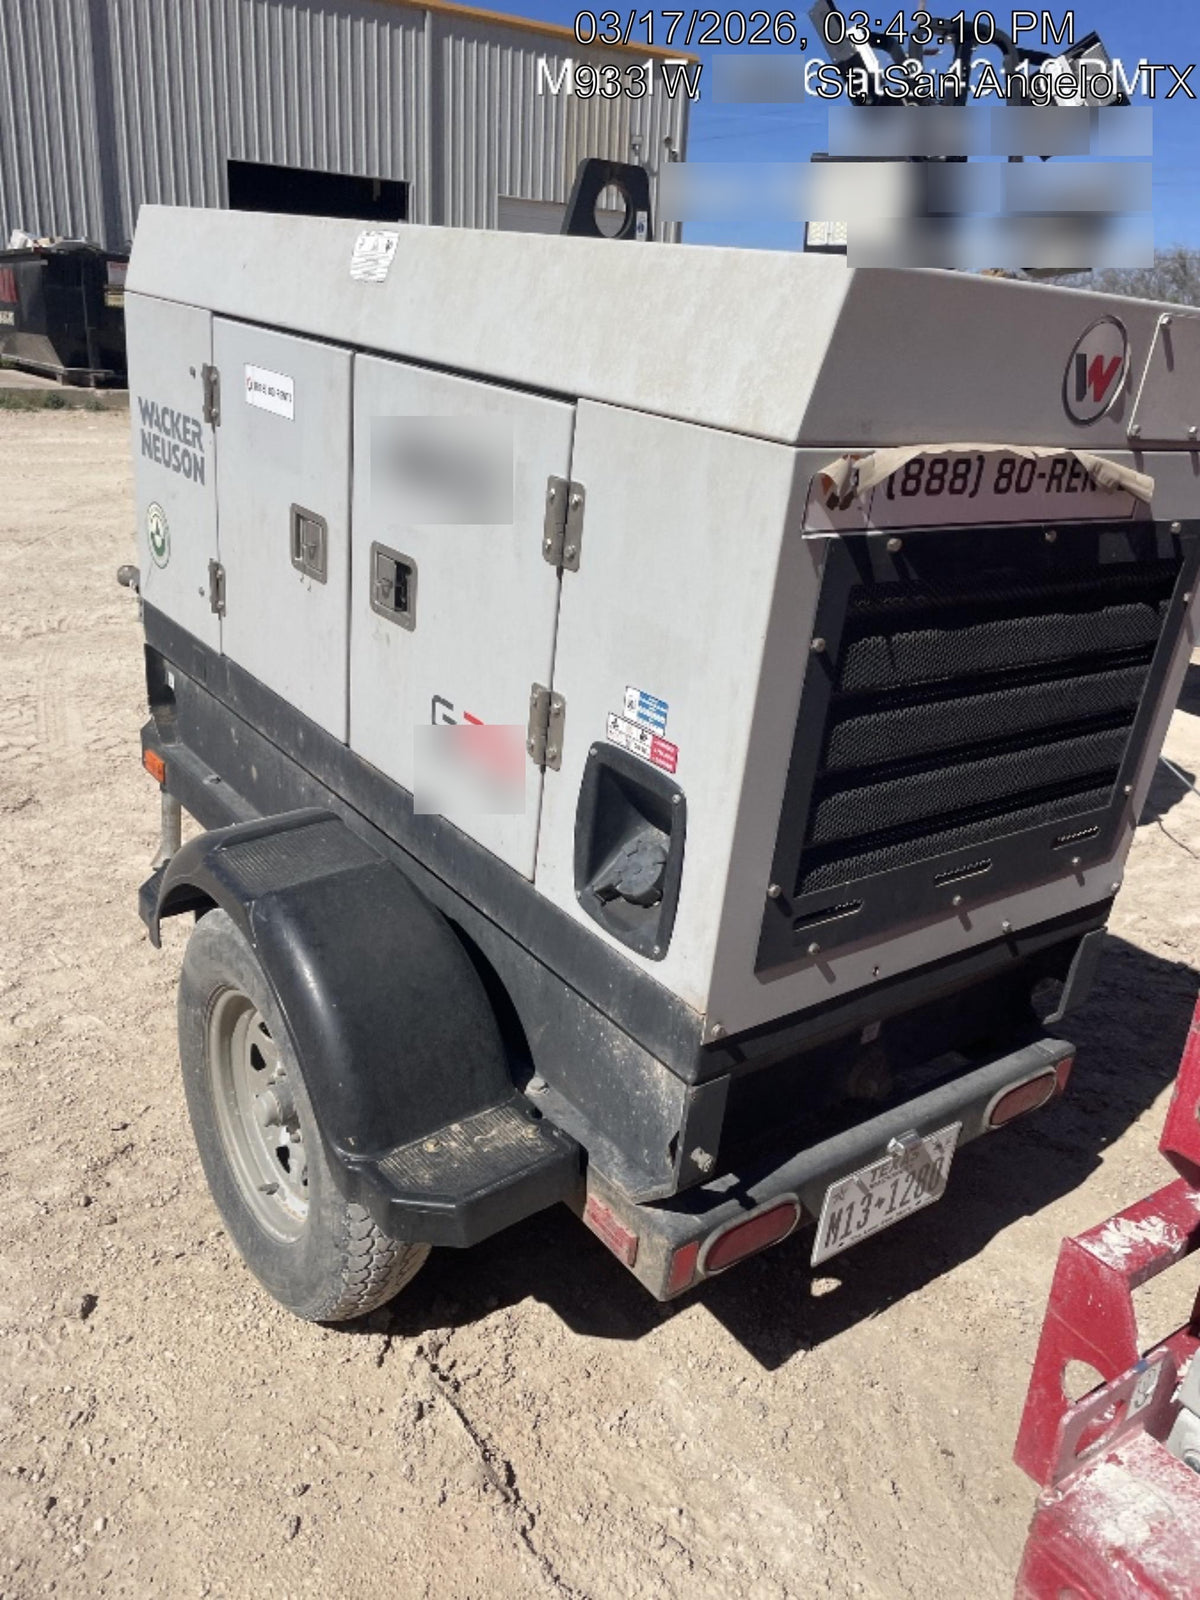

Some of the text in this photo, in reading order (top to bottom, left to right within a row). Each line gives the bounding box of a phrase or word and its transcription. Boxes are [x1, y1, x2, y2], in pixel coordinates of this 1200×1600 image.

[138, 396, 205, 454] WACKER
[141, 428, 206, 487] NEUSON
[886, 454, 985, 500] (888)
